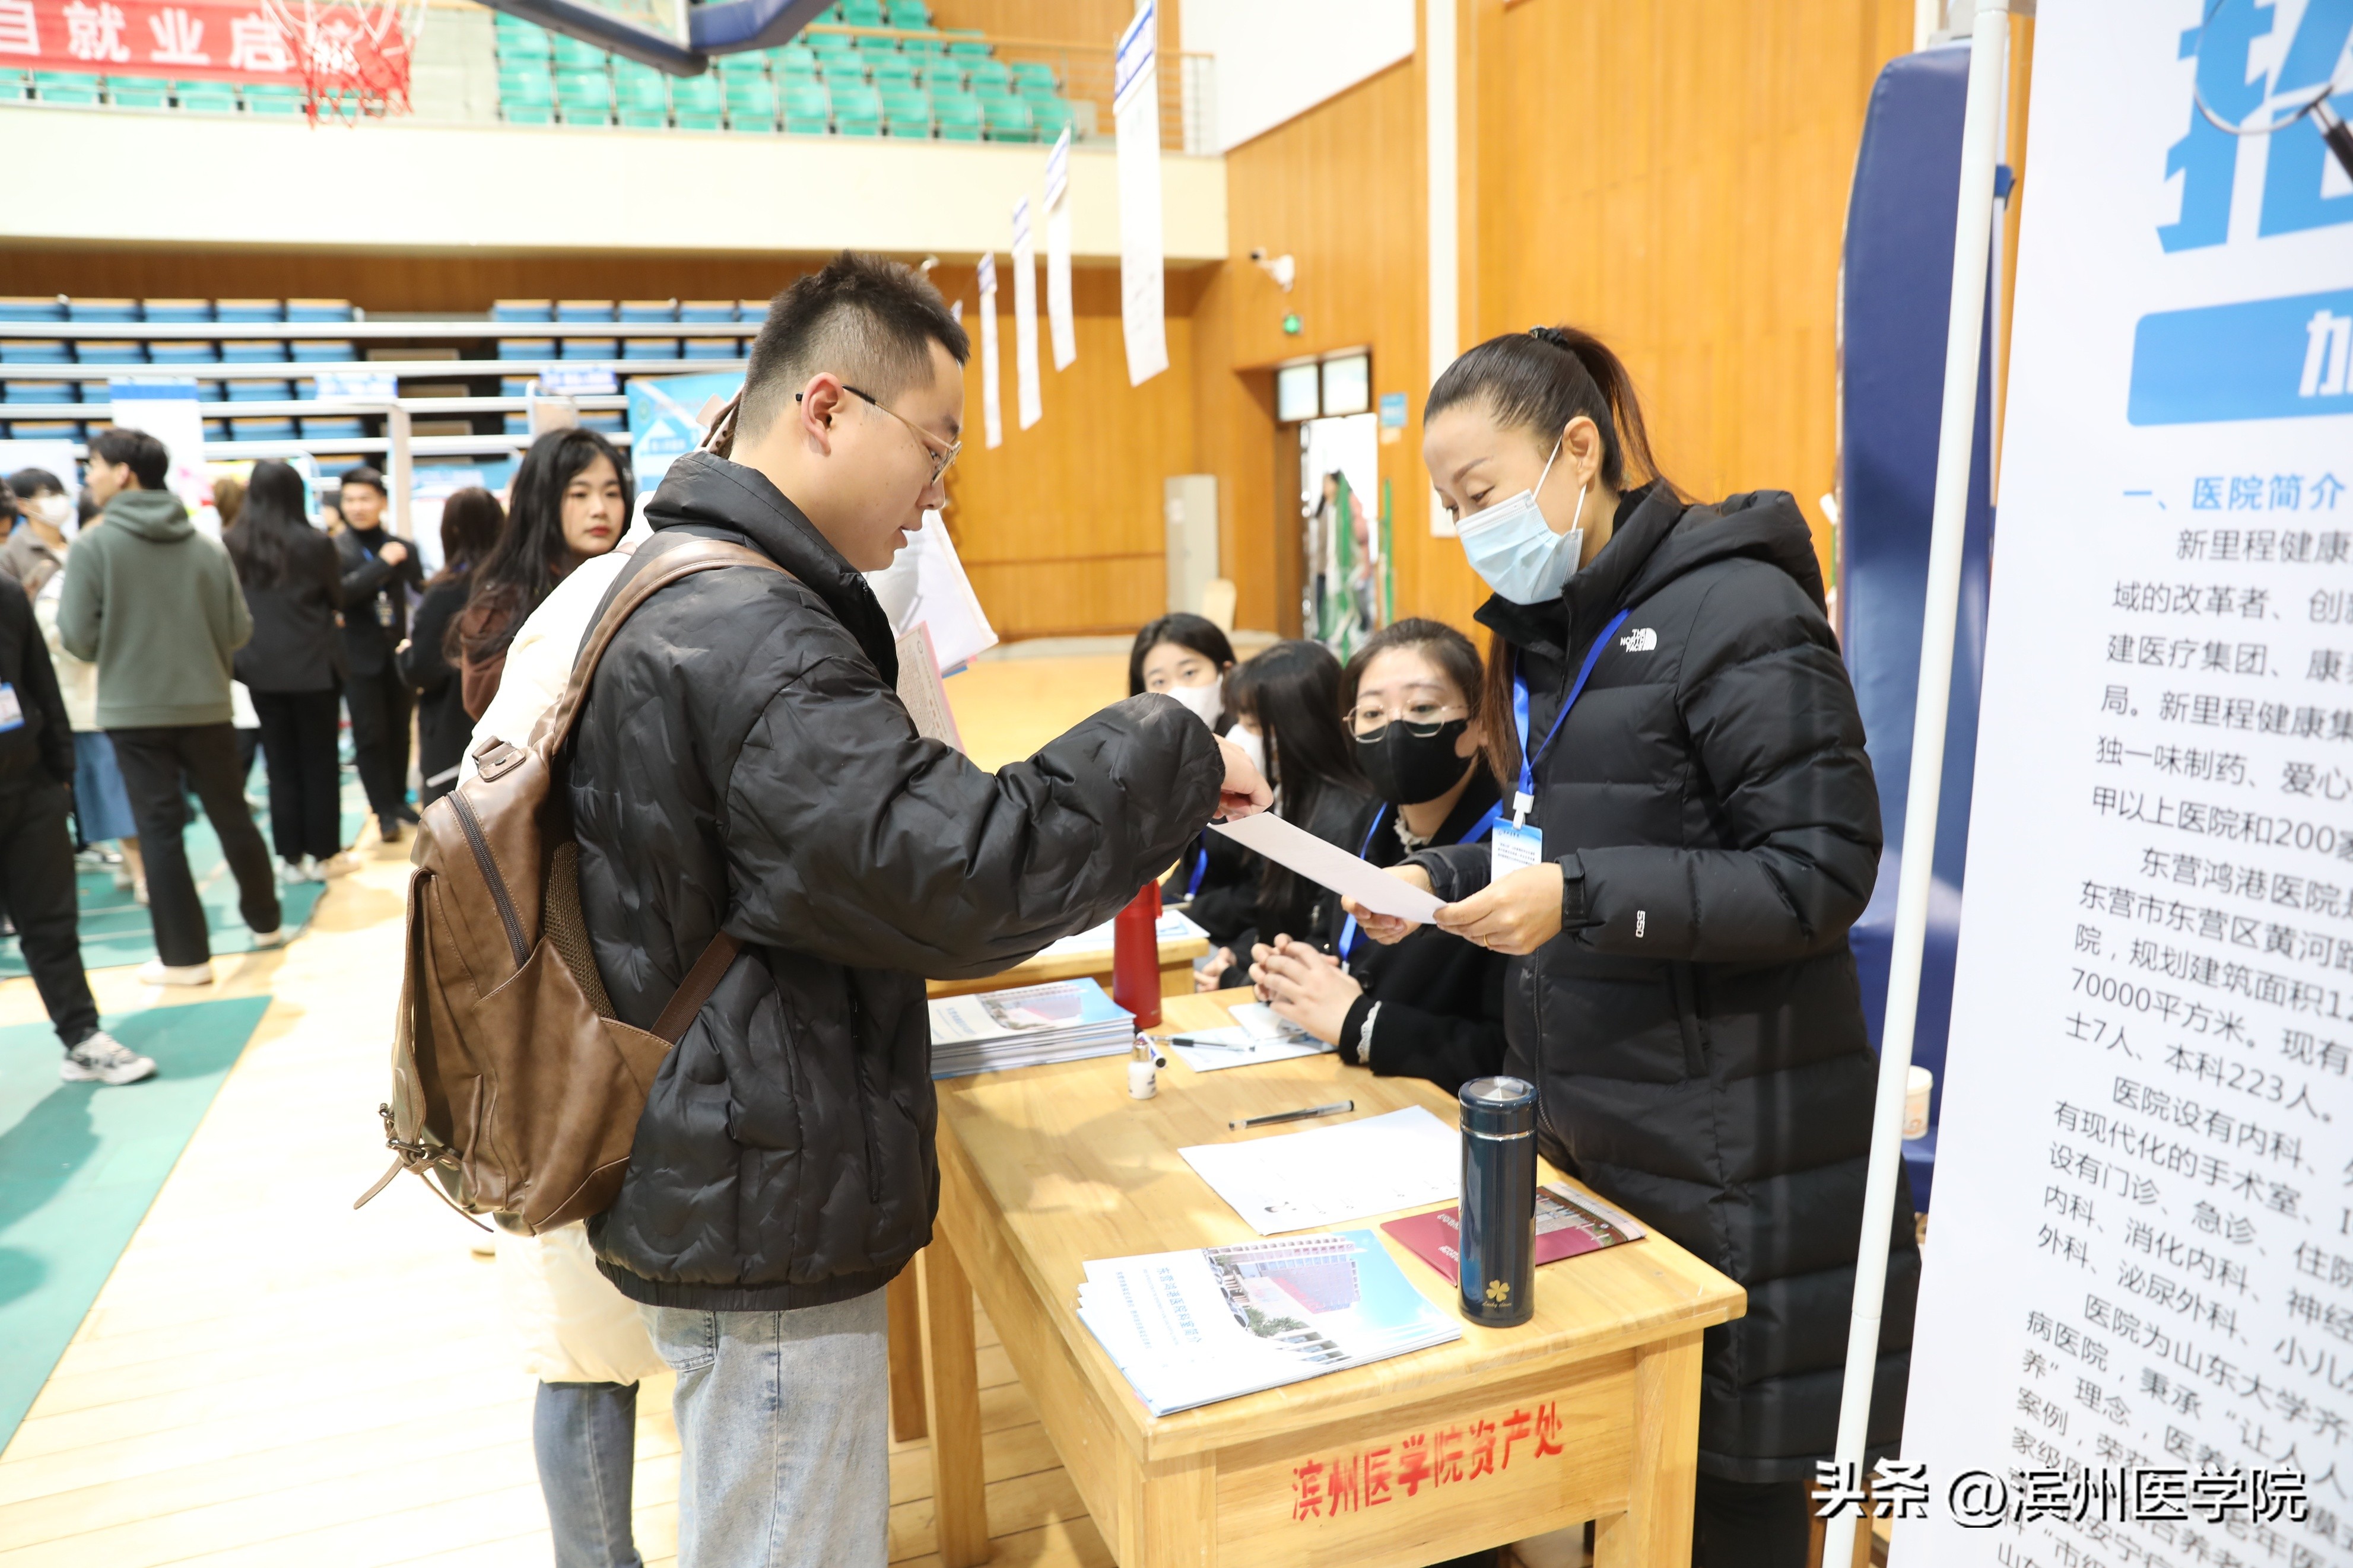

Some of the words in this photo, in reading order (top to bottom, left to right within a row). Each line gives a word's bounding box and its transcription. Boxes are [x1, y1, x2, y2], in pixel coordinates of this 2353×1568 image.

[2123, 473, 2345, 511] 一、医院简介
[2112, 580, 2353, 625] 域的改革者、创
[2106, 633, 2353, 683] 建医疗集团、康
[1636, 910, 1646, 938] 550
[2075, 923, 2353, 1023] 院，规划建筑面积1
[2113, 1076, 2353, 1187] 医院设有内科、
[2038, 1223, 2353, 1394] 外科、泌尿外科、小儿
[1291, 1400, 1564, 1521] 滨州医学院资产处
